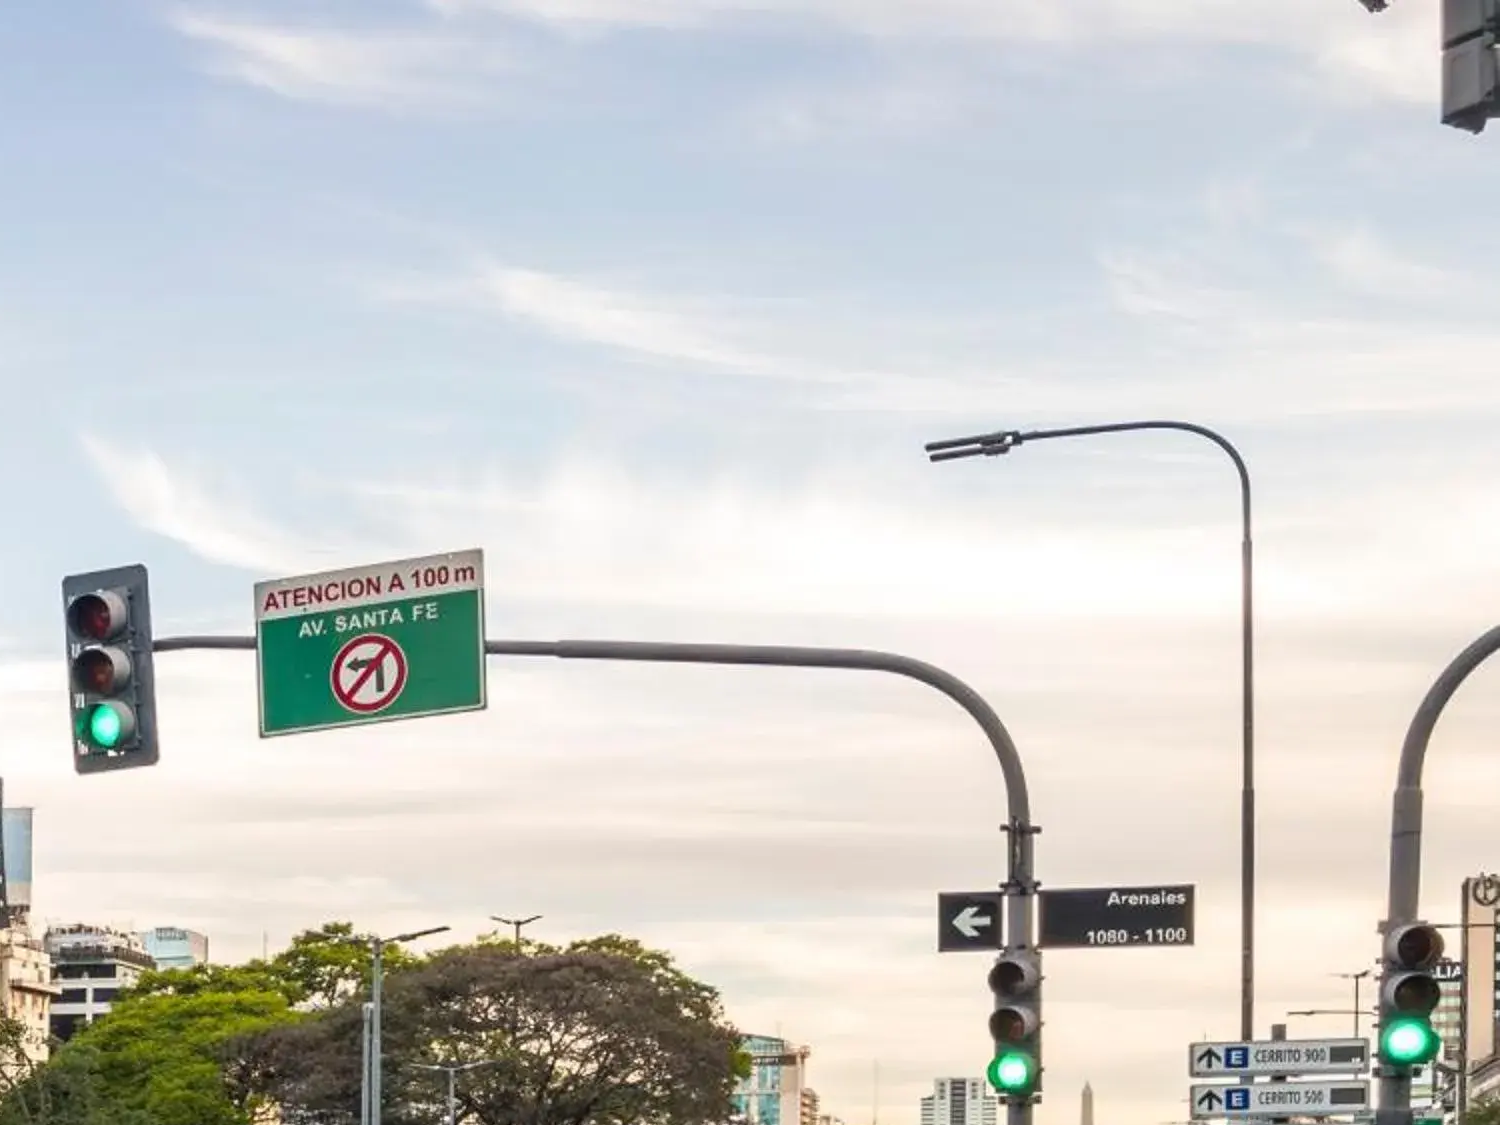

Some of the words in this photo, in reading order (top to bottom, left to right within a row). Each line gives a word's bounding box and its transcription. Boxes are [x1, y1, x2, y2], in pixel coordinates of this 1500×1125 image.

[263, 576, 381, 612] ATENCION
[388, 573, 405, 592] A
[411, 566, 449, 589] 100
[455, 565, 475, 582] m
[298, 619, 327, 638] AV.
[335, 607, 404, 632] SANTA
[412, 602, 439, 622] FE
[1107, 889, 1187, 906] Arenales
[1086, 929, 1128, 944] 1080
[1145, 928, 1187, 943] 1100
[1254, 1049, 1300, 1063] CERRITO
[1257, 1091, 1300, 1105] CERRITO
[1304, 1090, 1324, 1105] 500
